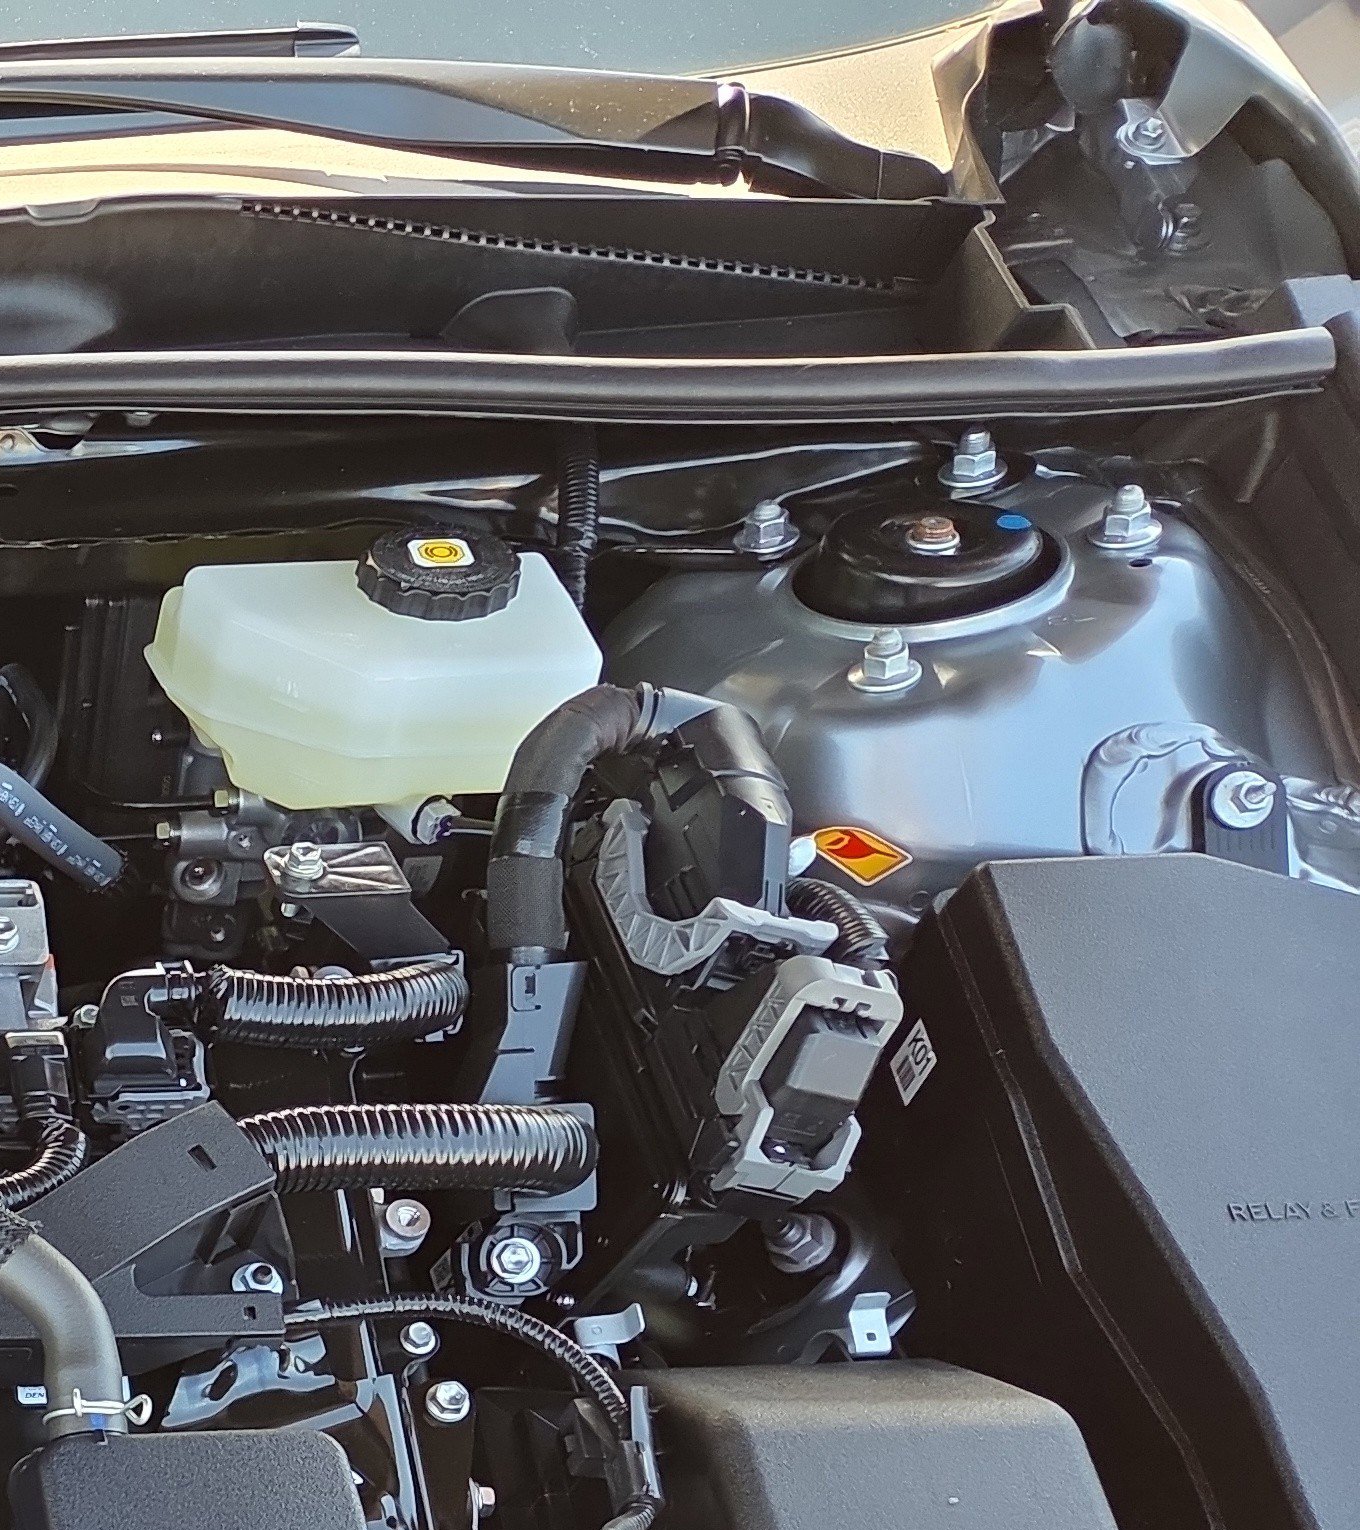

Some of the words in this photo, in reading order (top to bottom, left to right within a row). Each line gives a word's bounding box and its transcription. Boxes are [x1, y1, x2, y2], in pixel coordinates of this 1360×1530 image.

[908, 1028, 931, 1077] K01
[1226, 1202, 1311, 1221] RELAY
[1321, 1201, 1339, 1219] &
